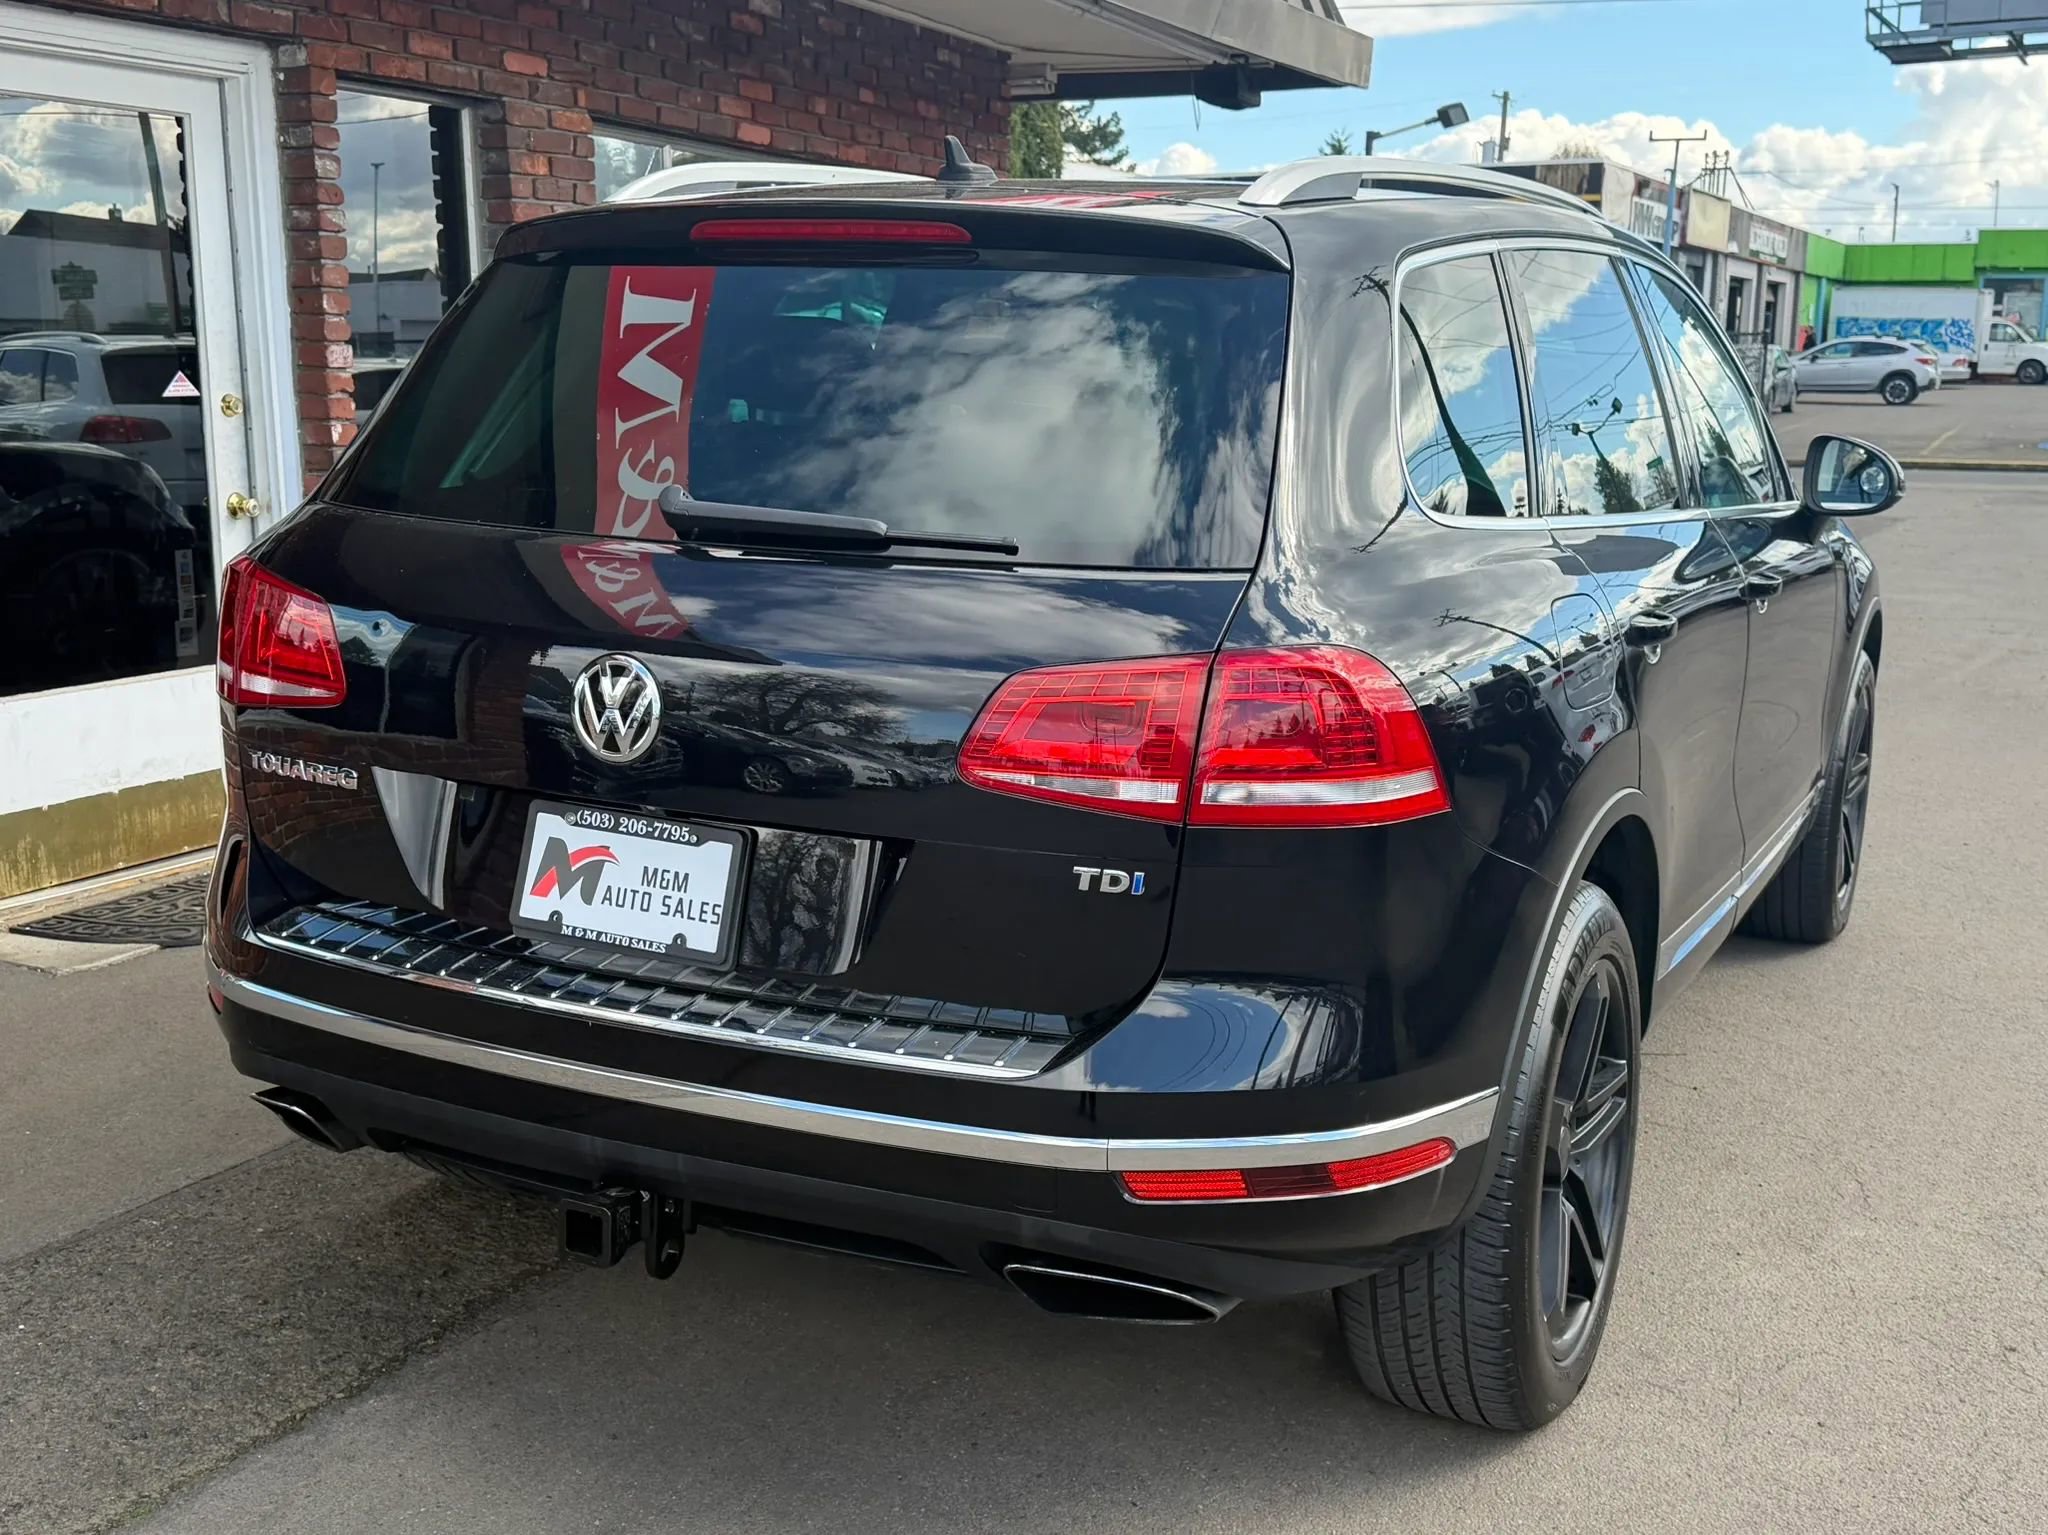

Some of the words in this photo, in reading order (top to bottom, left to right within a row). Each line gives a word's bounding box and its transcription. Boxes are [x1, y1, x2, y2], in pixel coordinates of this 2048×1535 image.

[573, 653, 661, 764] VW
[247, 750, 359, 790] TOUAREG
[576, 809, 615, 829] (503)
[618, 816, 690, 843] 206-7795
[641, 865, 690, 894] M&M
[1073, 866, 1145, 896] TDI
[601, 885, 652, 913] AUTO
[660, 895, 722, 925] SALES
[560, 925, 574, 936] M
[575, 927, 584, 937] &
[585, 930, 598, 941] M
[599, 933, 630, 947] AUTO
[630, 938, 667, 954] SALES
